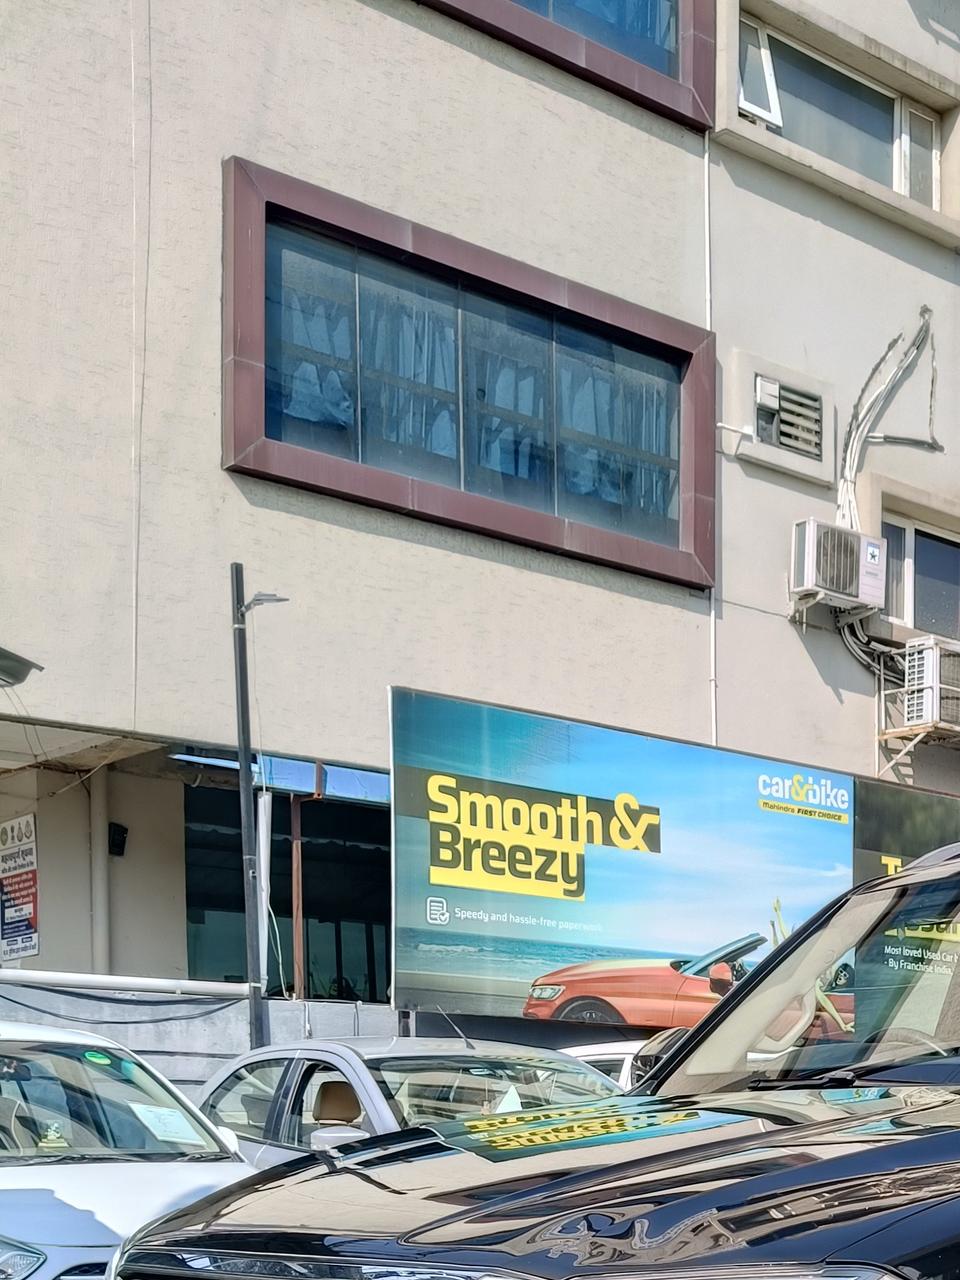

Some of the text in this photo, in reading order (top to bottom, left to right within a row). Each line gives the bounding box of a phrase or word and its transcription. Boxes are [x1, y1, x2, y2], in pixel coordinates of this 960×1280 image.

[758, 774, 849, 809] car&bike
[427, 774, 660, 851] Smooth &
[797, 808, 817, 817] FIRST
[818, 811, 842, 821] CHOICE
[430, 822, 585, 897] Breezy
[454, 908, 488, 921] Speedy
[490, 911, 507, 922] and
[509, 914, 557, 928] hassle-free
[884, 945, 901, 955] Most
[903, 946, 922, 957] loved
[923, 949, 941, 961] Used
[942, 953, 953, 963] Car
[888, 959, 899, 970] By
[900, 960, 934, 973] Franchise
